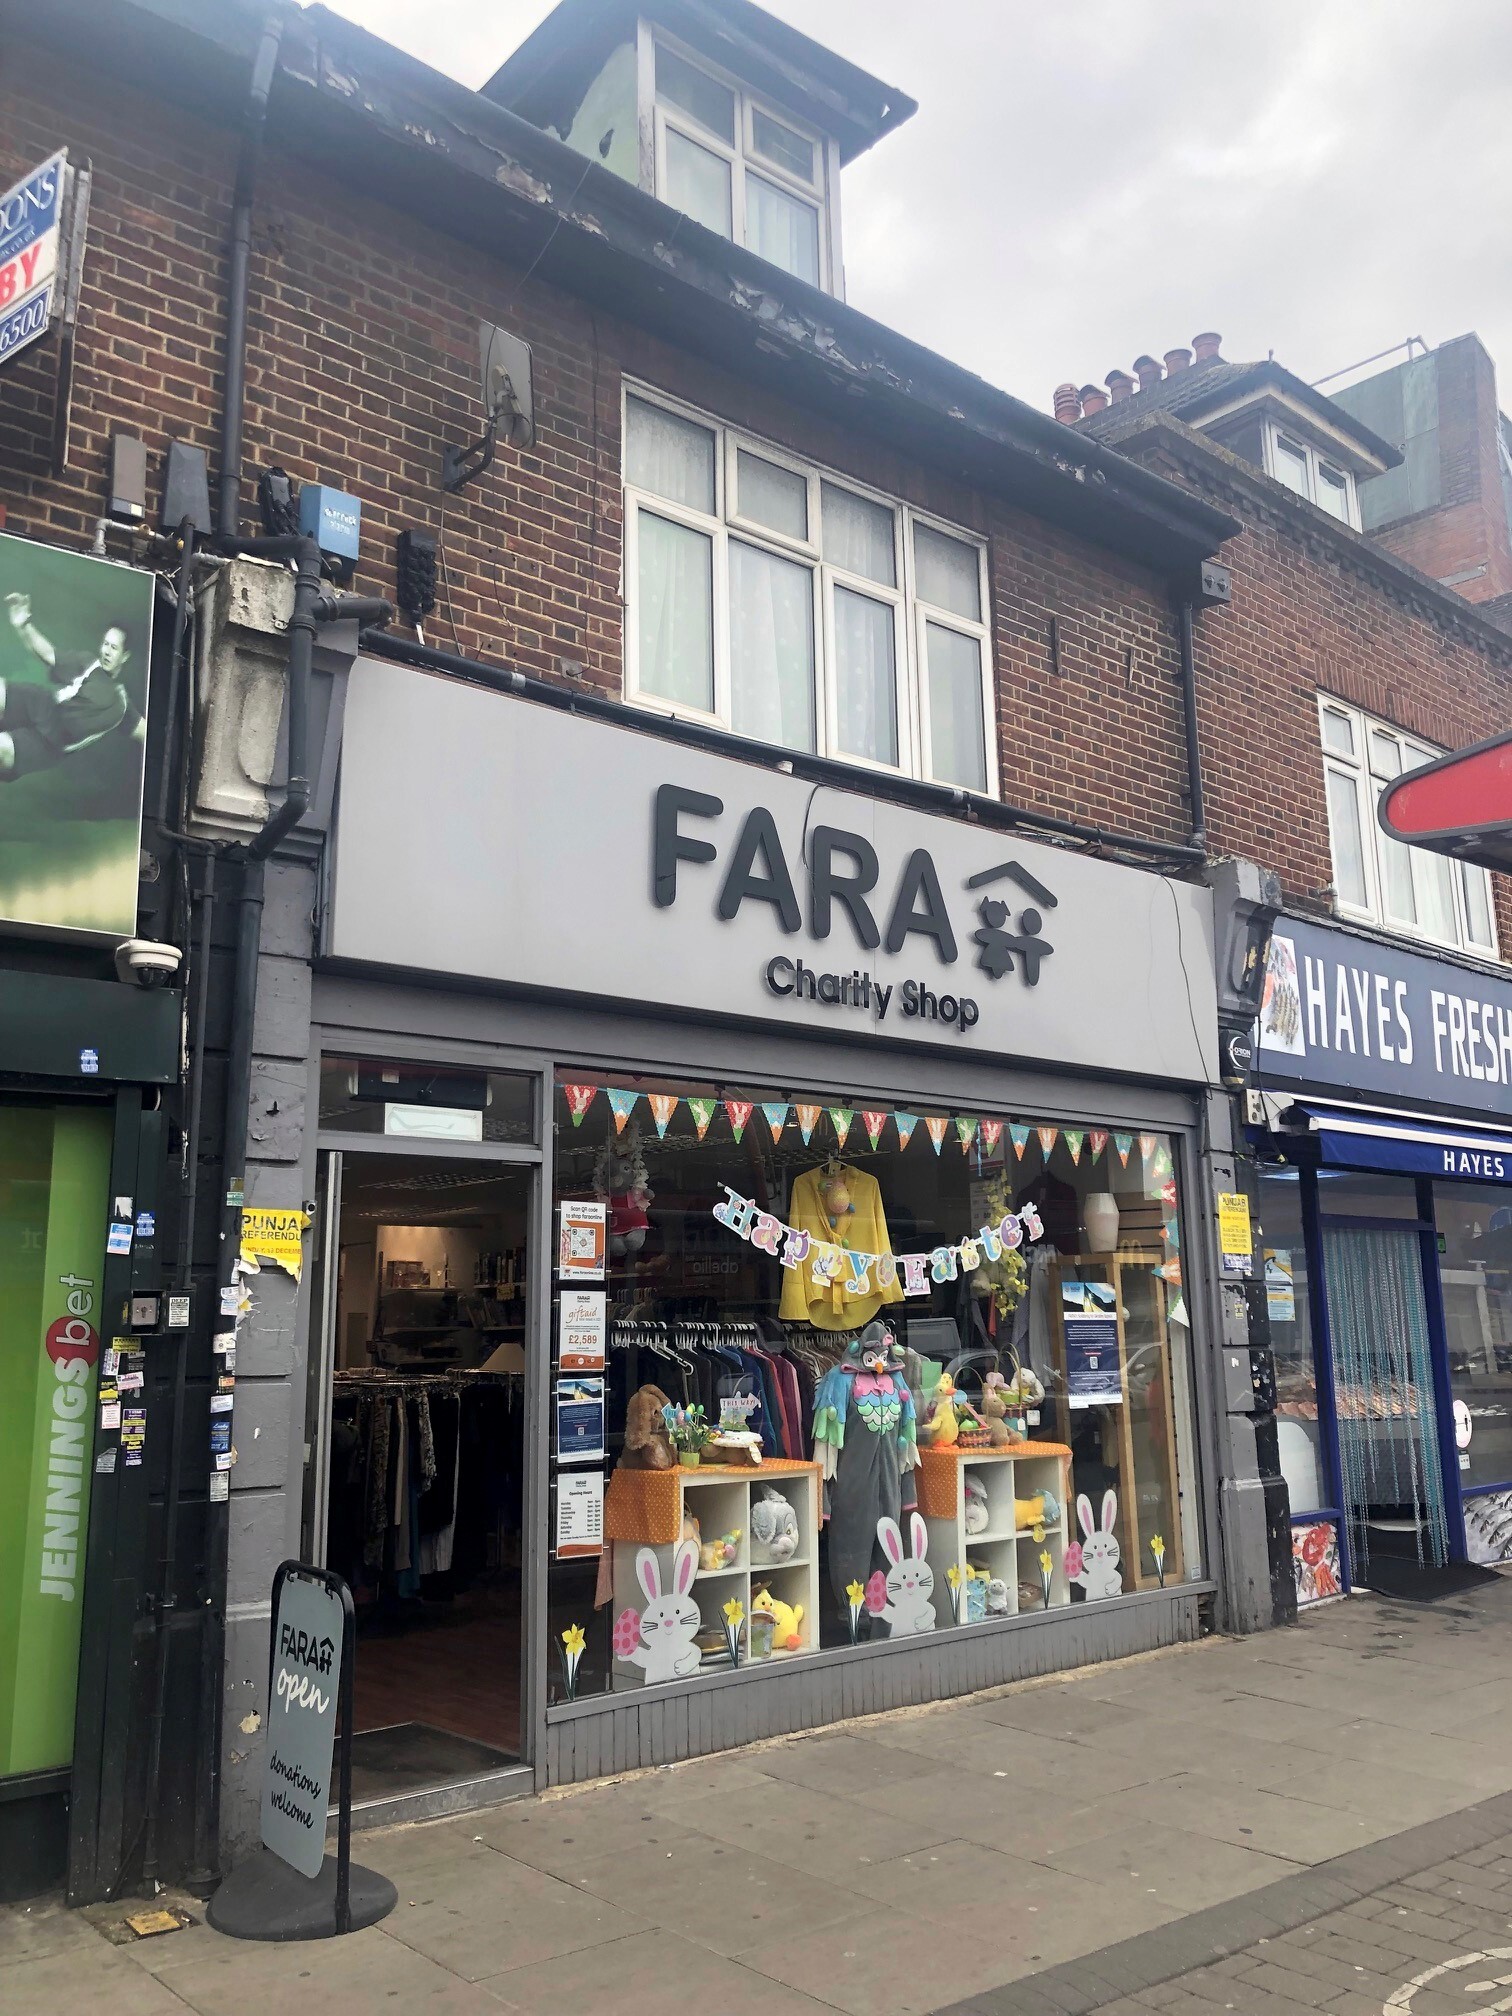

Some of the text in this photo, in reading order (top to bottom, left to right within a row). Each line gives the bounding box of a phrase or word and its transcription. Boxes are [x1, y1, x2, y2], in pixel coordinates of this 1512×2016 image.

[0, 299, 44, 351] 6500
[655, 784, 958, 963] FARA
[767, 955, 980, 1032] Charity Shop
[1304, 955, 1512, 1085] HAYES FRESH
[1443, 1150, 1505, 1178] HAYES
[712, 1186, 1045, 1297] Happy Easter
[568, 1334, 597, 1345] £2,589
[280, 1623, 320, 1672] FARA
[276, 1667, 330, 1715] open
[270, 1749, 322, 1801] donations
[270, 1789, 314, 1830] welcome
